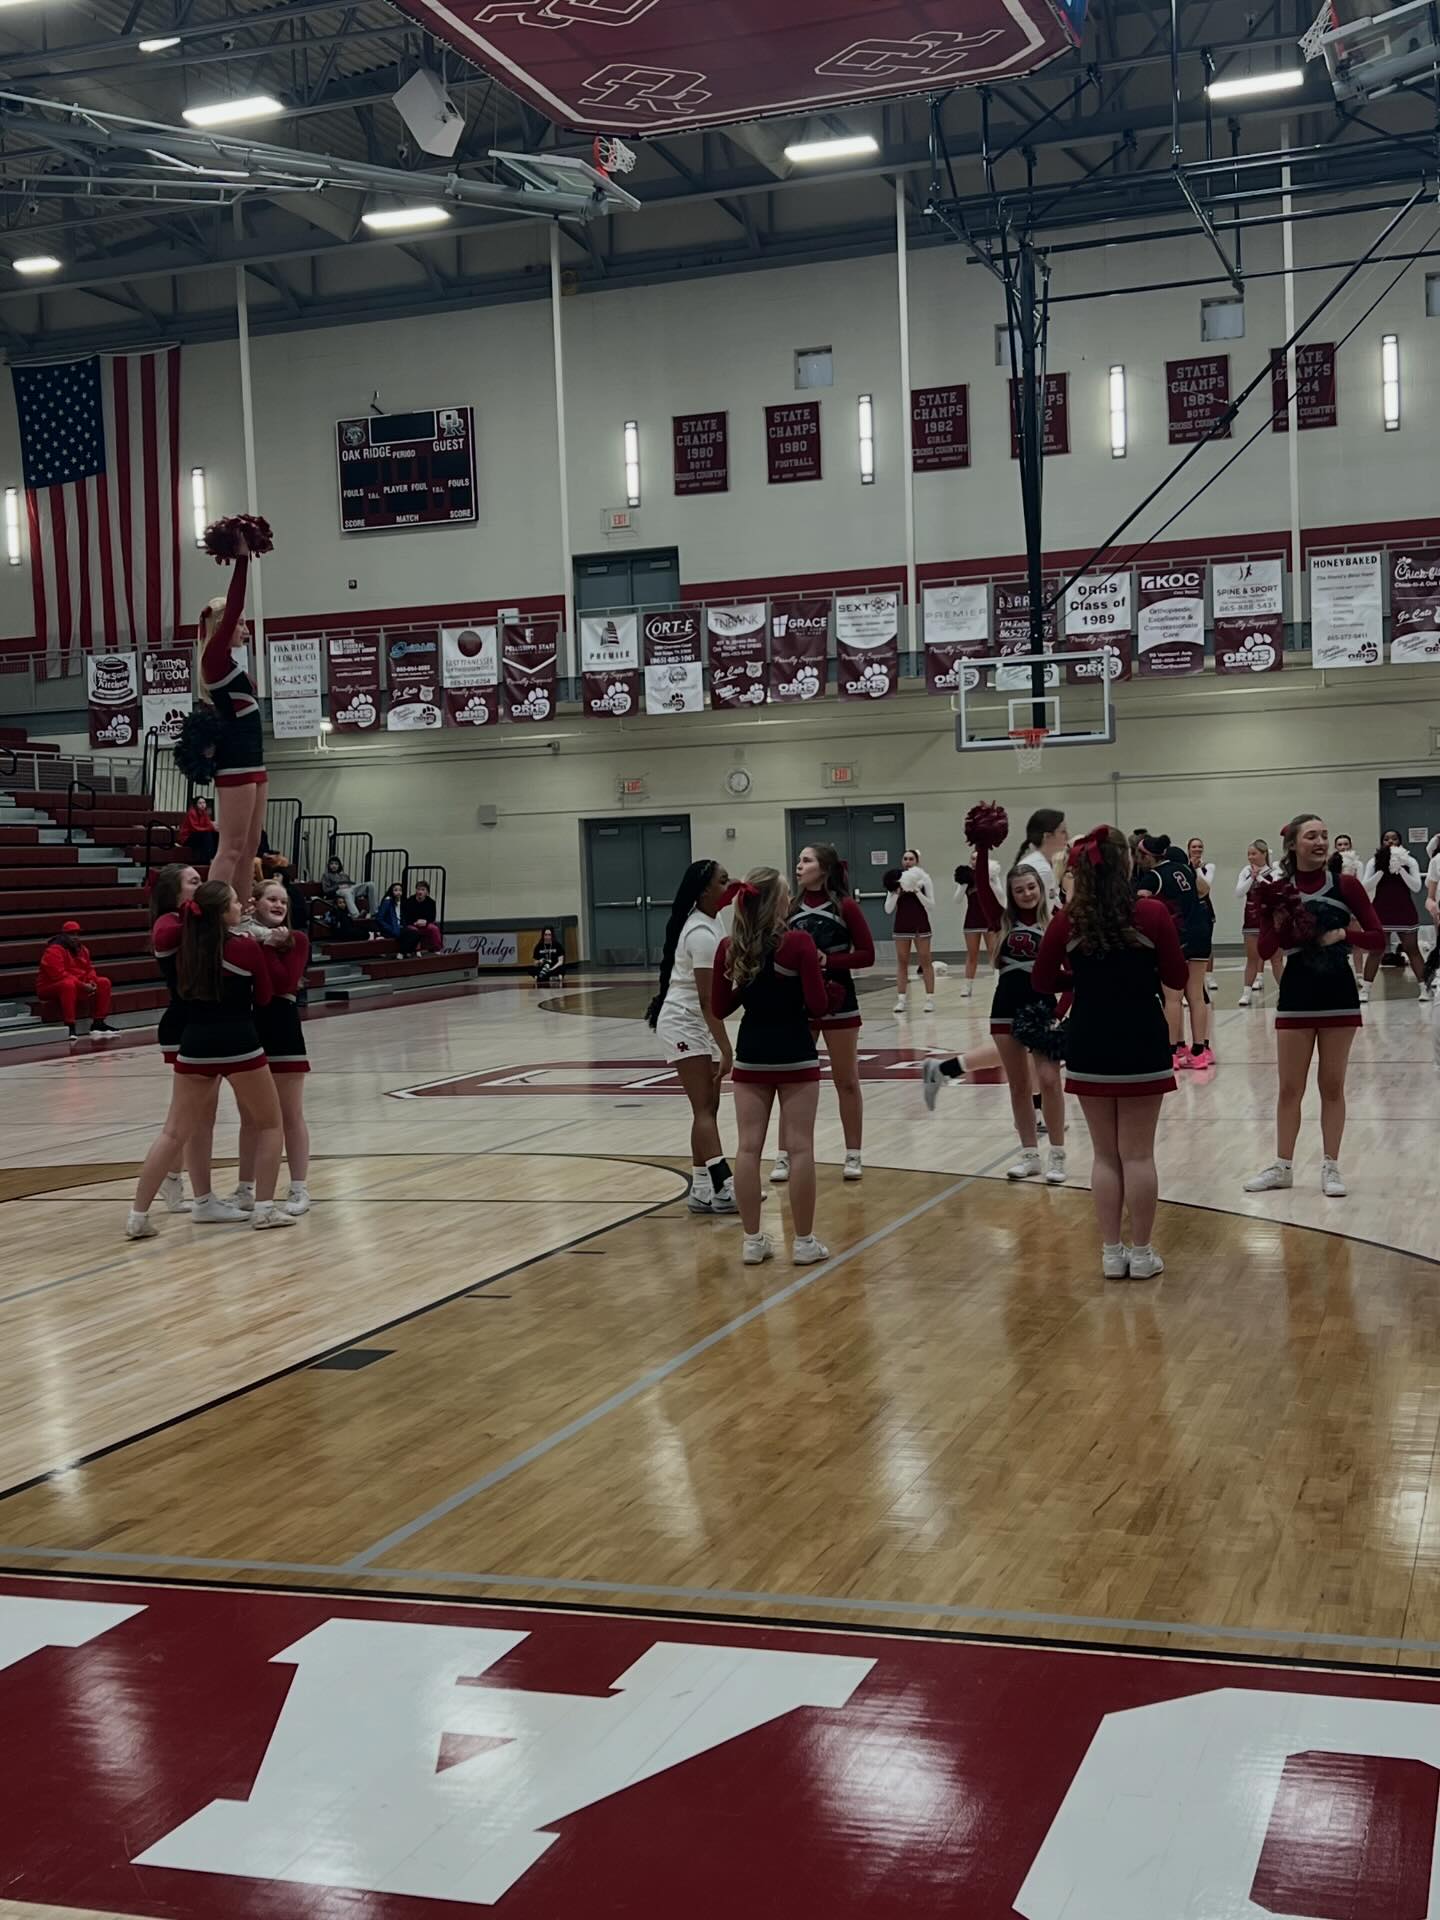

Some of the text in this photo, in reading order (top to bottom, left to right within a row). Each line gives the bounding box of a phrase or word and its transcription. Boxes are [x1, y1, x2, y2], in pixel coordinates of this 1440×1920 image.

[1281, 351, 1323, 366] SATE
[1177, 363, 1217, 379] STATE
[1276, 364, 1331, 380] CAMPS
[1171, 376, 1225, 393] CHAMPS
[919, 391, 957, 406] STATE
[773, 409, 810, 423] STATE
[913, 405, 963, 420] CHAMPS
[1187, 408, 1210, 418] BOYS
[682, 419, 717, 433] STATE
[769, 423, 817, 438] CHAMPS
[925, 420, 953, 433] 1982
[1170, 421, 1193, 430] CROSS
[676, 432, 723, 446] CHAMPS
[927, 434, 952, 445] GIRLS
[433, 438, 465, 452] GUEST
[779, 440, 807, 454] 1980
[935, 444, 968, 454] COUNTRY
[342, 446, 391, 461] OAK RIDGE
[392, 449, 416, 459] PERIOD
[687, 447, 714, 459] 1980
[690, 460, 711, 469] BOYS
[775, 457, 814, 468] FOOTBALL
[696, 469, 727, 479] COUNTRY
[448, 478, 470, 487] FOULS
[343, 489, 364, 498] FOULS
[383, 483, 428, 494] PLAYER FOUL
[396, 514, 419, 523] MATCH
[450, 509, 471, 518] SCORE
[345, 519, 365, 528] SCORE
[1313, 555, 1377, 568] HONEYBAKED
[1156, 572, 1200, 589] KOC
[1078, 583, 1118, 595] ORHS
[1217, 588, 1240, 597] SPINE
[1250, 585, 1278, 594] SPORT
[1070, 596, 1126, 611] Class of
[925, 608, 987, 619] PREMIER
[1398, 608, 1432, 622] Go Cats
[788, 617, 827, 628] GRACE
[1082, 614, 1115, 625] 1989
[1217, 620, 1246, 630] Proudly
[651, 619, 694, 635] ORT-E
[1069, 634, 1096, 645] Proudly
[274, 642, 315, 653] OAK RIDGE
[929, 645, 954, 655] Proudly
[1000, 645, 1011, 657] Go
[273, 654, 302, 663] FLORAL
[590, 650, 630, 660] PREMIER
[774, 655, 798, 666] Proudly
[841, 651, 865, 662] Proudly
[1223, 650, 1270, 662] ORHS
[585, 671, 609, 682] Proudly
[713, 669, 725, 681] Go
[506, 676, 529, 688] Proudly
[778, 682, 816, 692] ORHS
[846, 680, 886, 690] ORHS
[511, 702, 547, 714] ORHS
[590, 698, 627, 708] ORHS
[336, 709, 373, 719] ORHS
[455, 709, 486, 719] ORHS
[96, 729, 129, 738] ORHS
[1173, 871, 1191, 892] 2
[468, 935, 516, 963] Ridge
